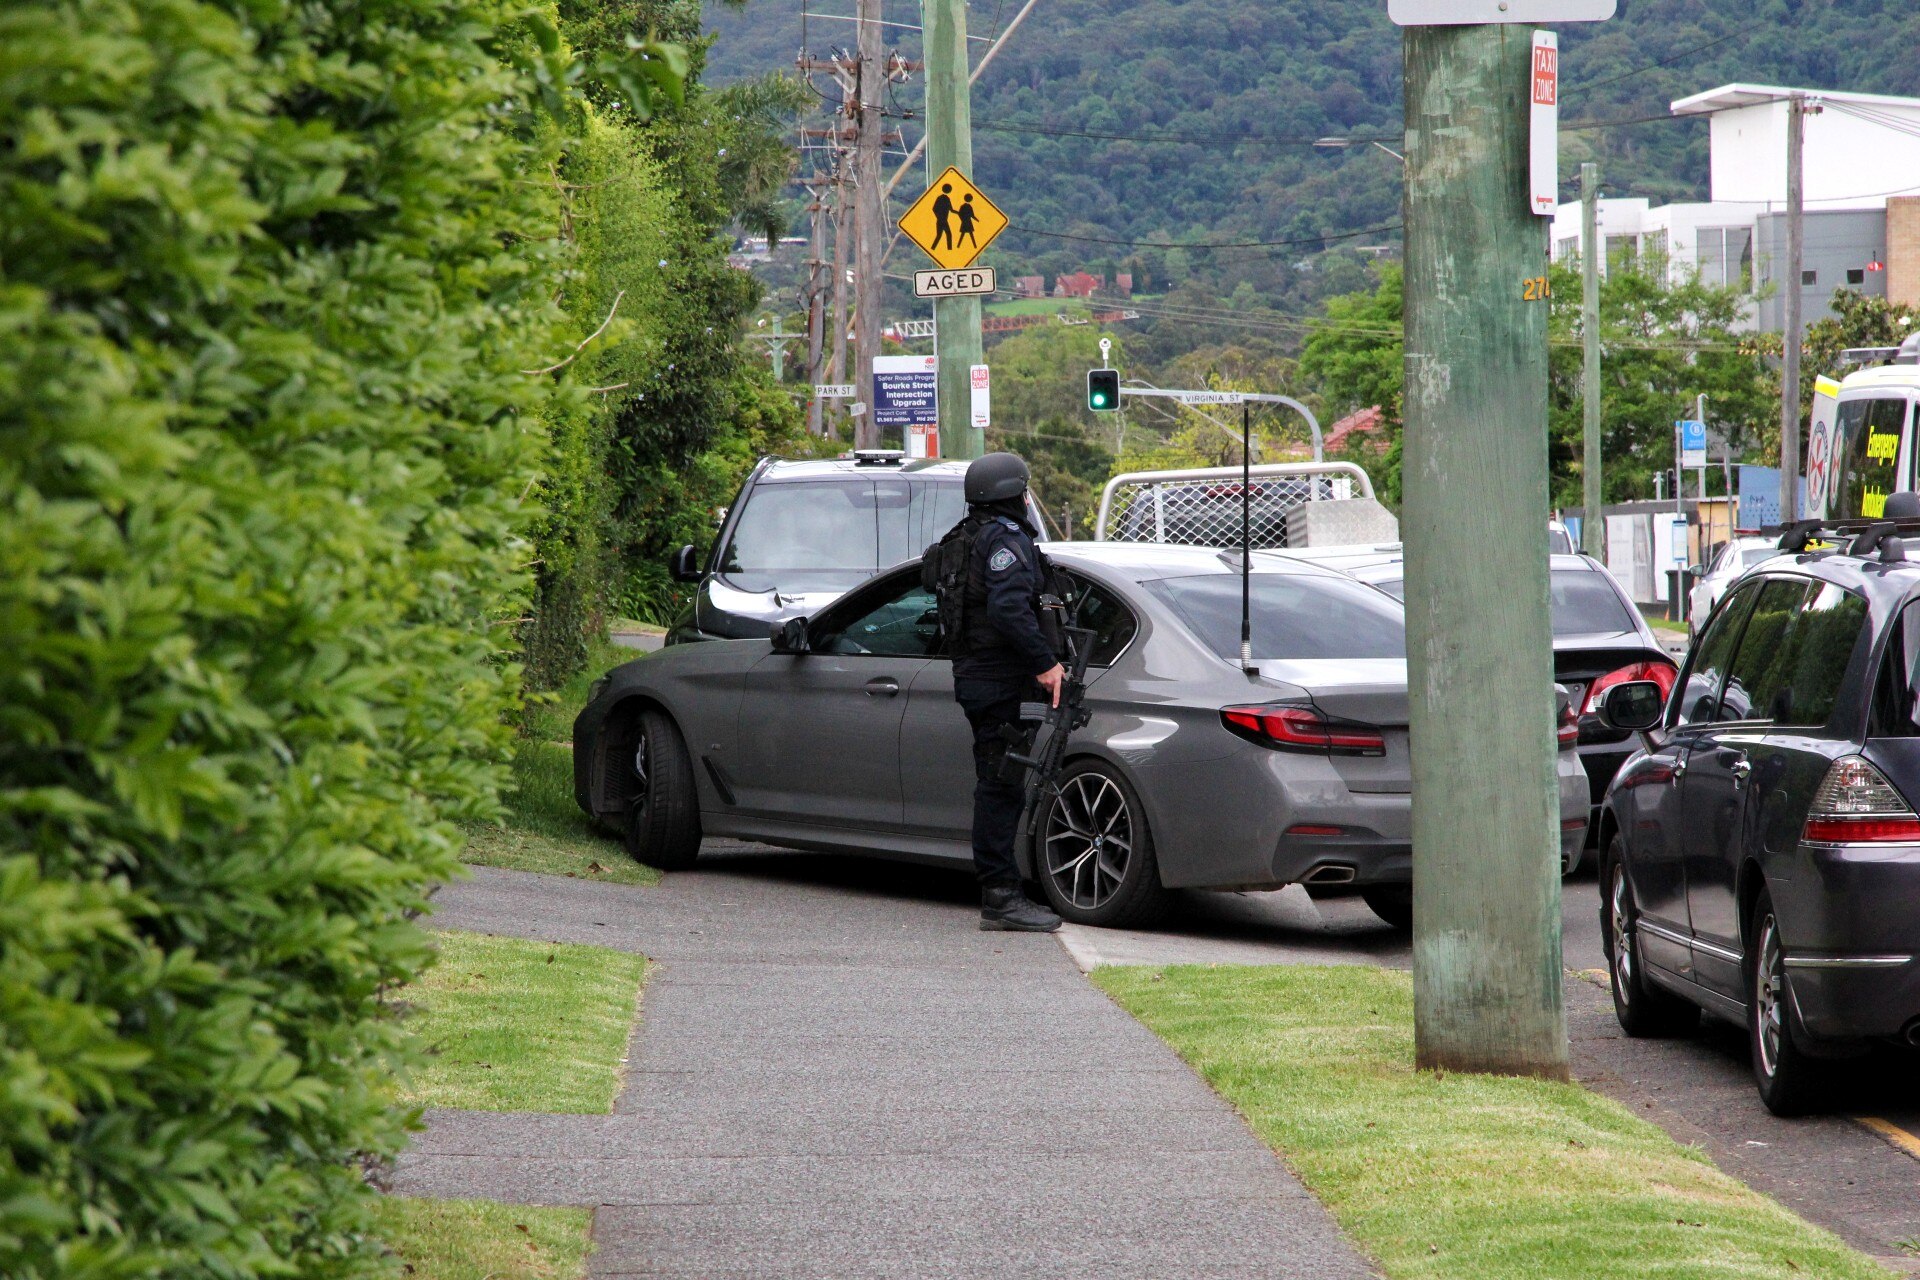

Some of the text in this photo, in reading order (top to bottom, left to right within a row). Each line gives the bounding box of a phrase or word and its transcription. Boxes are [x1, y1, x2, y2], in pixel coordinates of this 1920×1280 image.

[1536, 50, 1556, 73] TAXI
[1536, 79, 1553, 101] ZONE
[926, 273, 983, 290] AGED
[973, 370, 986, 378] BUS
[972, 380, 988, 388] ZONE
[817, 386, 851, 395] PARK ST
[1185, 394, 1224, 402] VIRGINIA
[893, 399, 927, 407] Upgrade
[1867, 425, 1899, 467] Emergency
